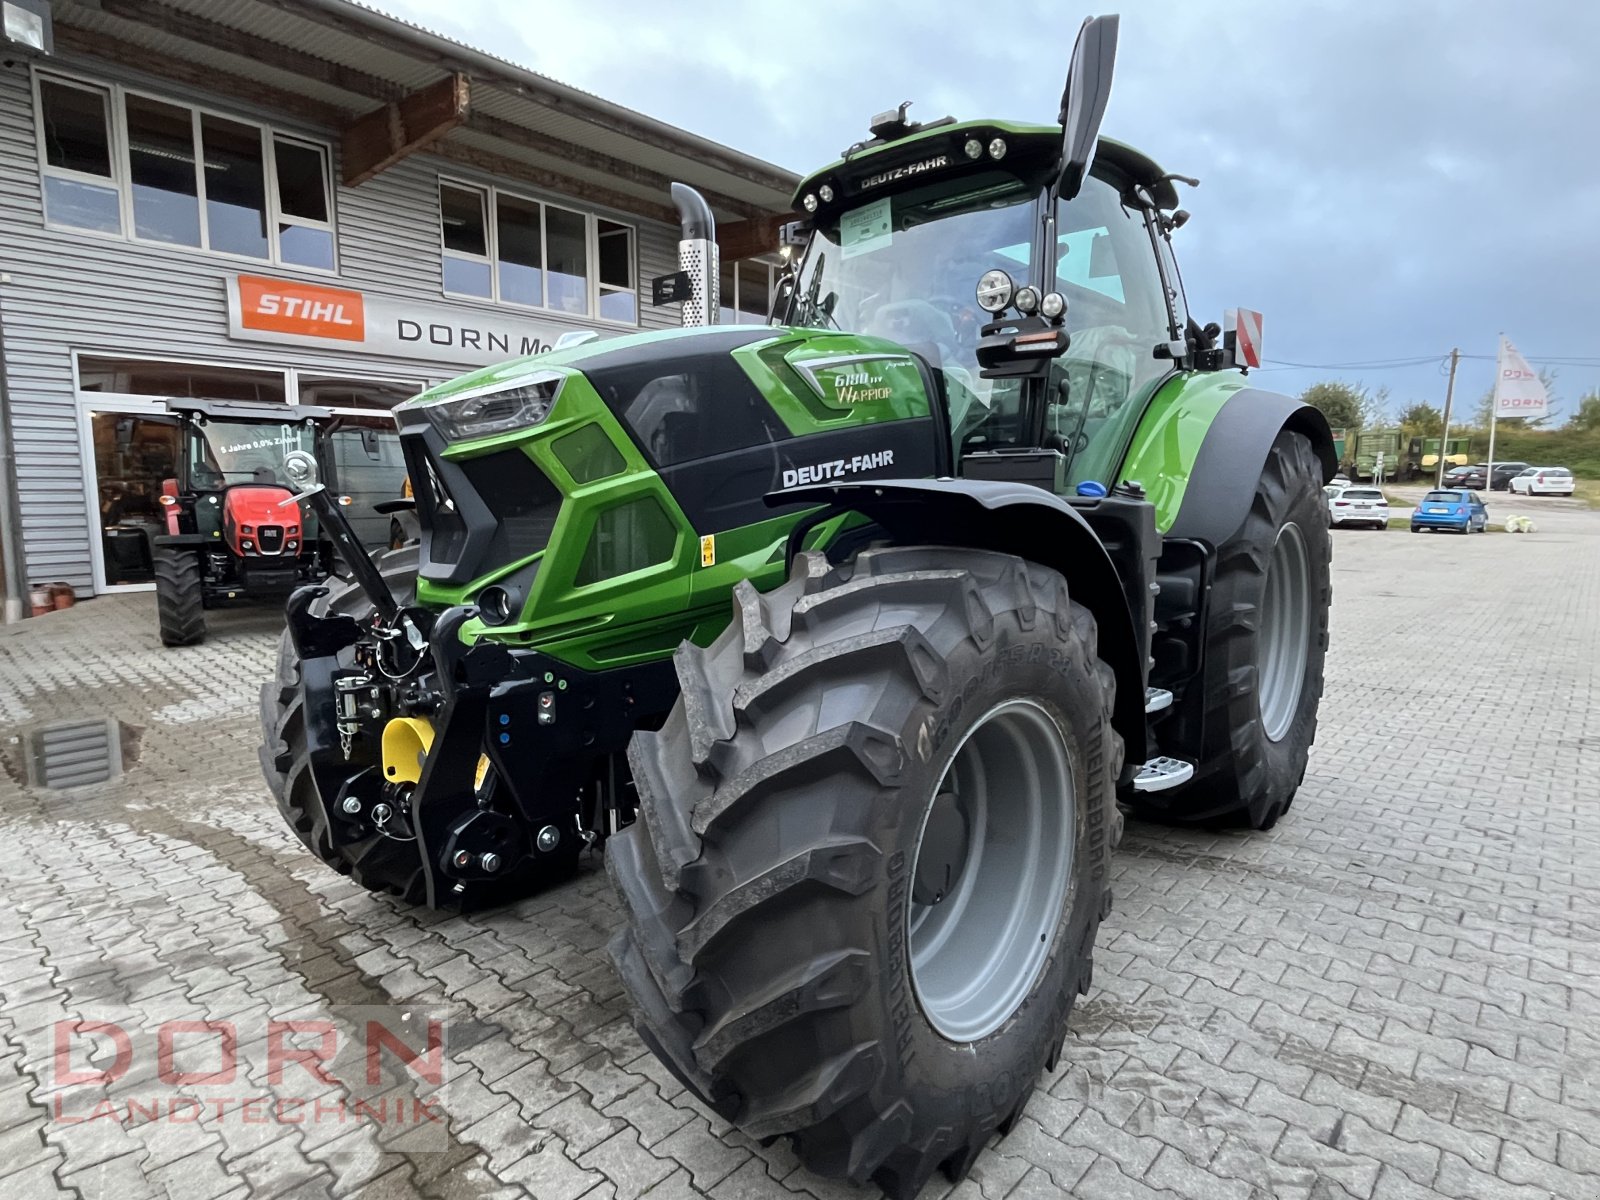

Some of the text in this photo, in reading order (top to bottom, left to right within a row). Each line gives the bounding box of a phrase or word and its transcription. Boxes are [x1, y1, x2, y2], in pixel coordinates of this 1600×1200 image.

[861, 155, 947, 189] DEUTZ-FAHR
[257, 294, 353, 325] STIHL
[398, 319, 509, 353] DORN
[228, 443, 252, 453] Jahre
[253, 439, 274, 449] 0,0%
[783, 450, 894, 488] DEUTZ-FAHR
[1086, 715, 1104, 883] TRELLEBORG
[886, 850, 916, 1068] TRELLEBORG
